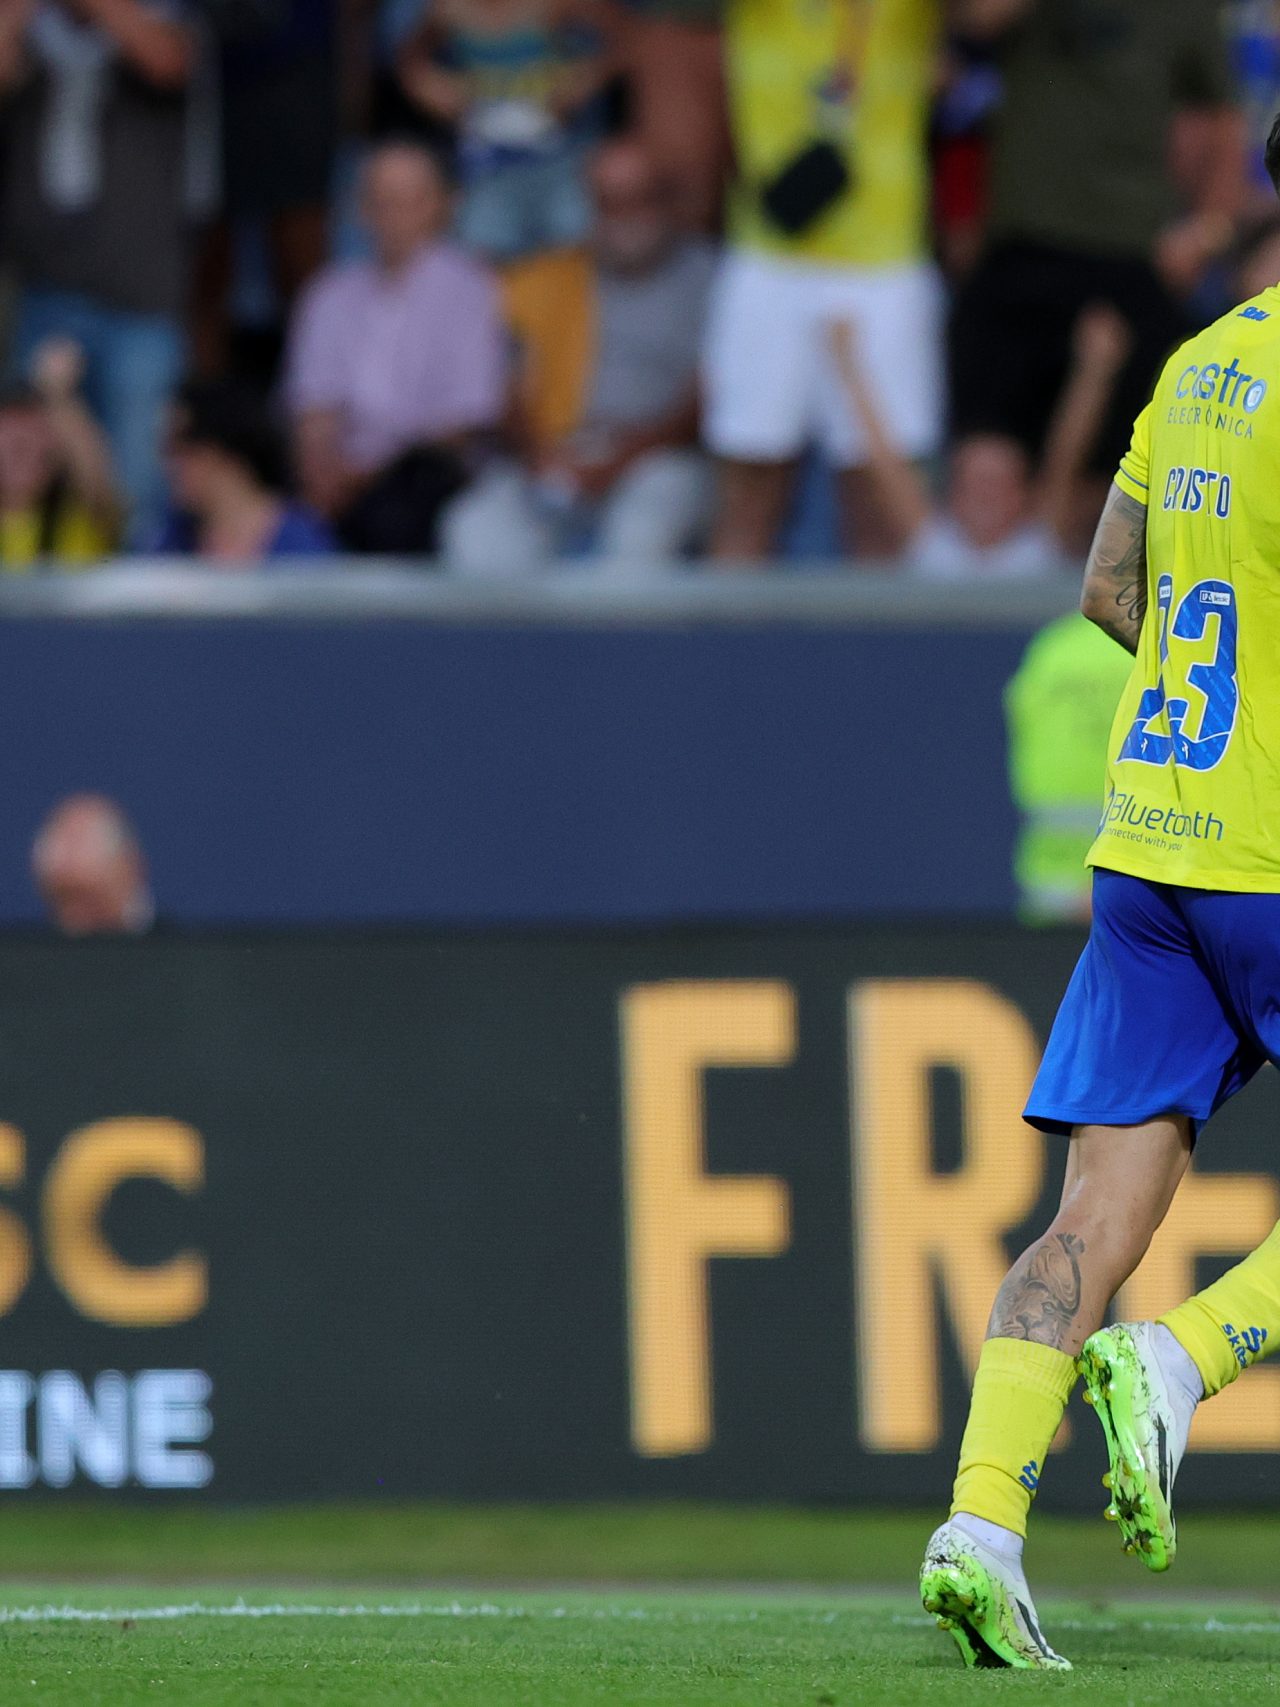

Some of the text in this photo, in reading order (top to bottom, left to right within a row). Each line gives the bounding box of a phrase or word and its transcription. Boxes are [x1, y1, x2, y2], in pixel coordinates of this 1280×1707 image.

[1163, 466, 1231, 519] CRISTO
[1114, 573, 1240, 772] 23
[1108, 793, 1223, 841] Bluetooth
[1145, 836, 1167, 849] with
[0, 1114, 209, 1328] C
